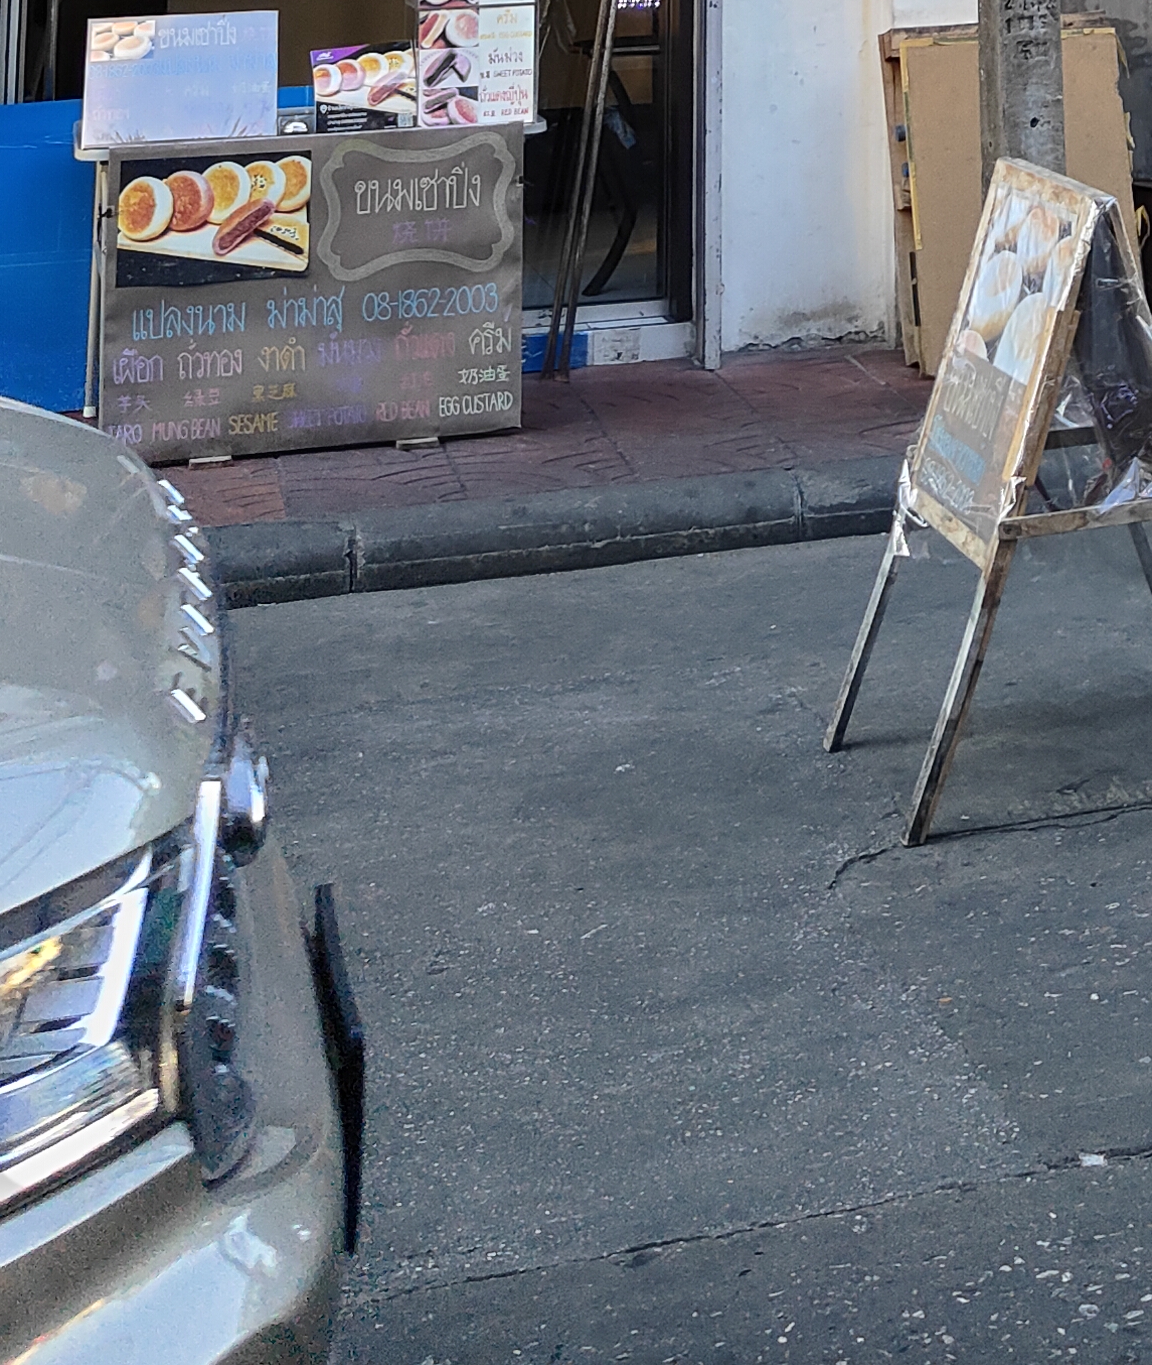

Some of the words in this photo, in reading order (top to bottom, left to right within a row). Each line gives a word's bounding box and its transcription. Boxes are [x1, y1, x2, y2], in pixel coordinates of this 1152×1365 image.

[132, 299, 247, 341] แปลงนาม
[362, 282, 499, 321] 08-1862-2003
[113, 347, 164, 385] เผือก
[177, 338, 243, 379] ถั่วทอง
[257, 337, 306, 373] งาดำ
[109, 423, 143, 446] TARO
[151, 419, 188, 442] MUNG
[190, 417, 221, 439] BEAN
[228, 411, 280, 436] SESAME
[439, 395, 460, 417] EGG
[462, 390, 514, 414] CUSTARD
